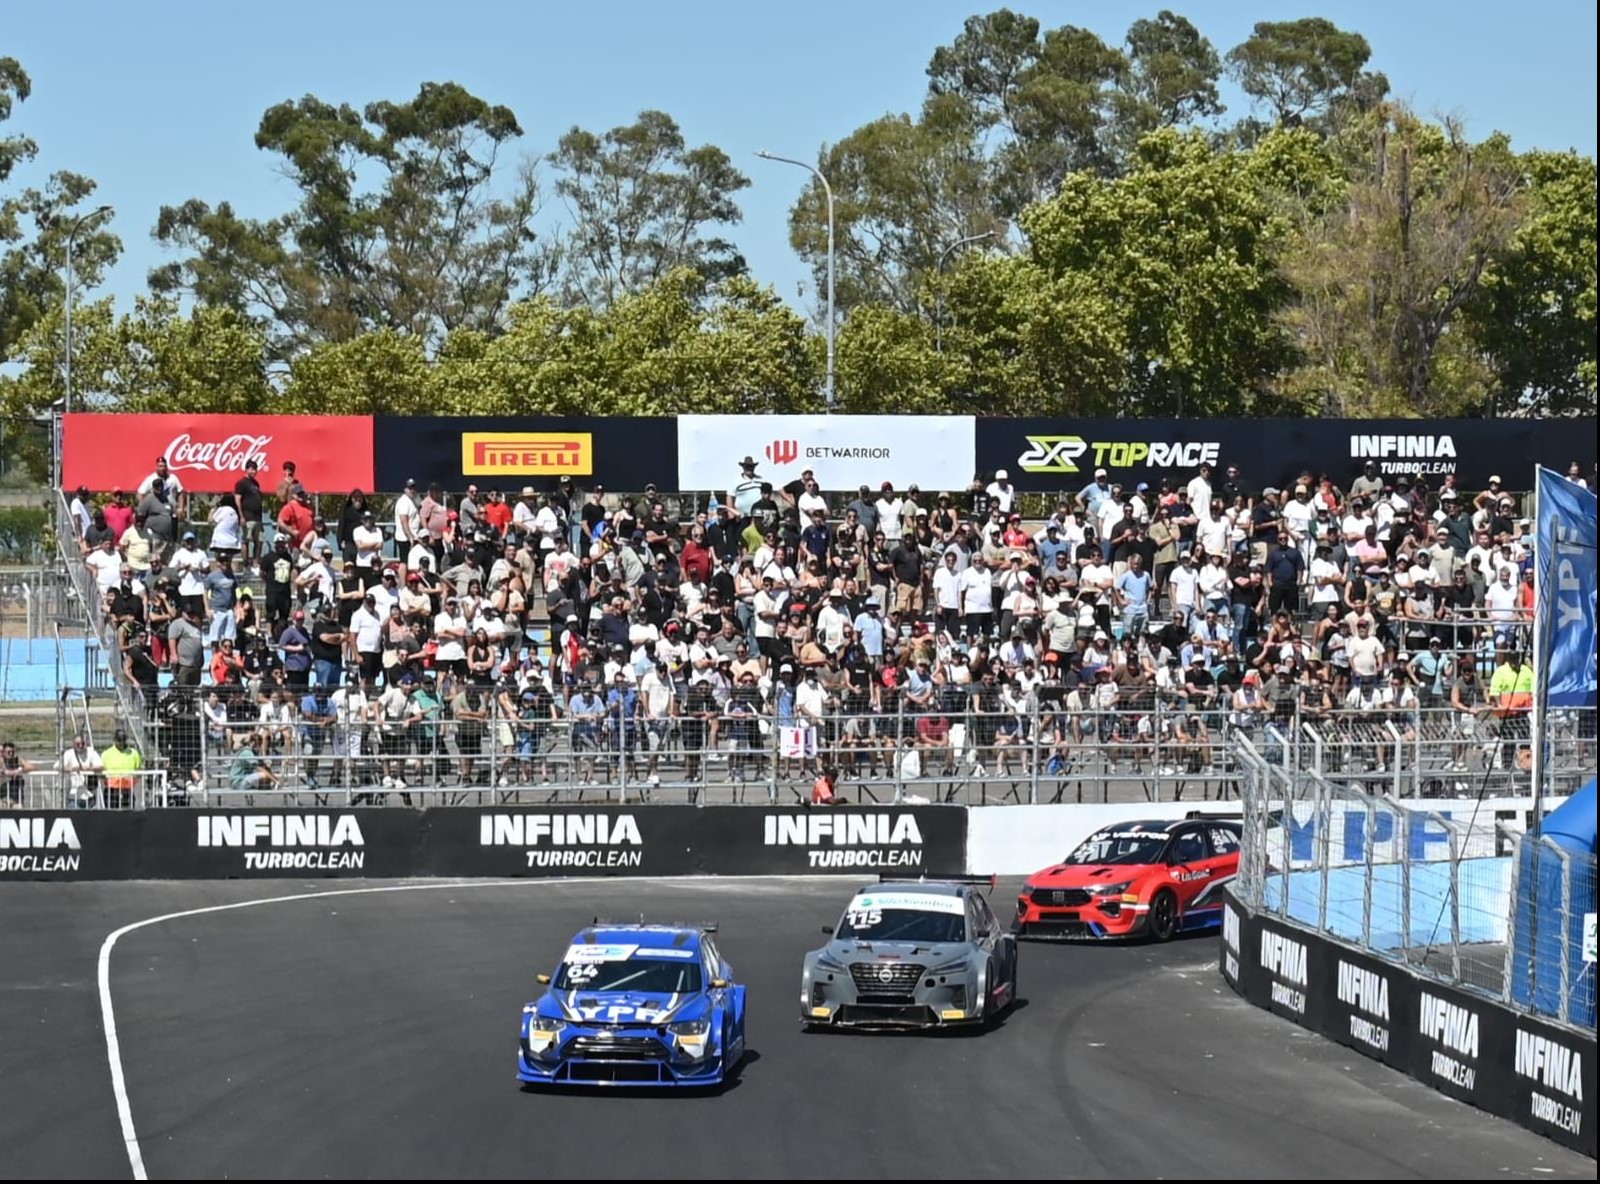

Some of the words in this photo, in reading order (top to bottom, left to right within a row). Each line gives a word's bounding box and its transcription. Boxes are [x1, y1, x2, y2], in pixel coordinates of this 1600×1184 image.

[163, 433, 273, 471] Coca-Cola
[474, 442, 580, 466] PIRELLI
[805, 447, 890, 459] BETWARRIOR
[1091, 442, 1220, 467] TOPRACE
[1350, 435, 1457, 457] INFINIA
[1380, 462, 1456, 474] TURBOCLEAN
[1557, 525, 1583, 629] YPF
[197, 815, 365, 846] INFINIA
[480, 814, 643, 846] INFINIA
[764, 814, 923, 845] INFINIA
[1282, 811, 1452, 860] YPF
[244, 851, 365, 869] TURBOCLEAN
[526, 850, 642, 867] TURBOCLEAN
[808, 850, 923, 867] TURBOCLEAN
[846, 911, 882, 926] 115
[567, 964, 599, 978] 64
[1261, 929, 1308, 986] INFINIA
[1337, 960, 1390, 1021] INFINIA
[1350, 1015, 1389, 1051] TURBOCLEAN
[1420, 992, 1478, 1059] INFINIA
[1431, 1050, 1476, 1090] TURBOCLEAN
[1515, 1028, 1583, 1101] INFINIA
[1531, 1091, 1582, 1136] TURBOCLEAN
